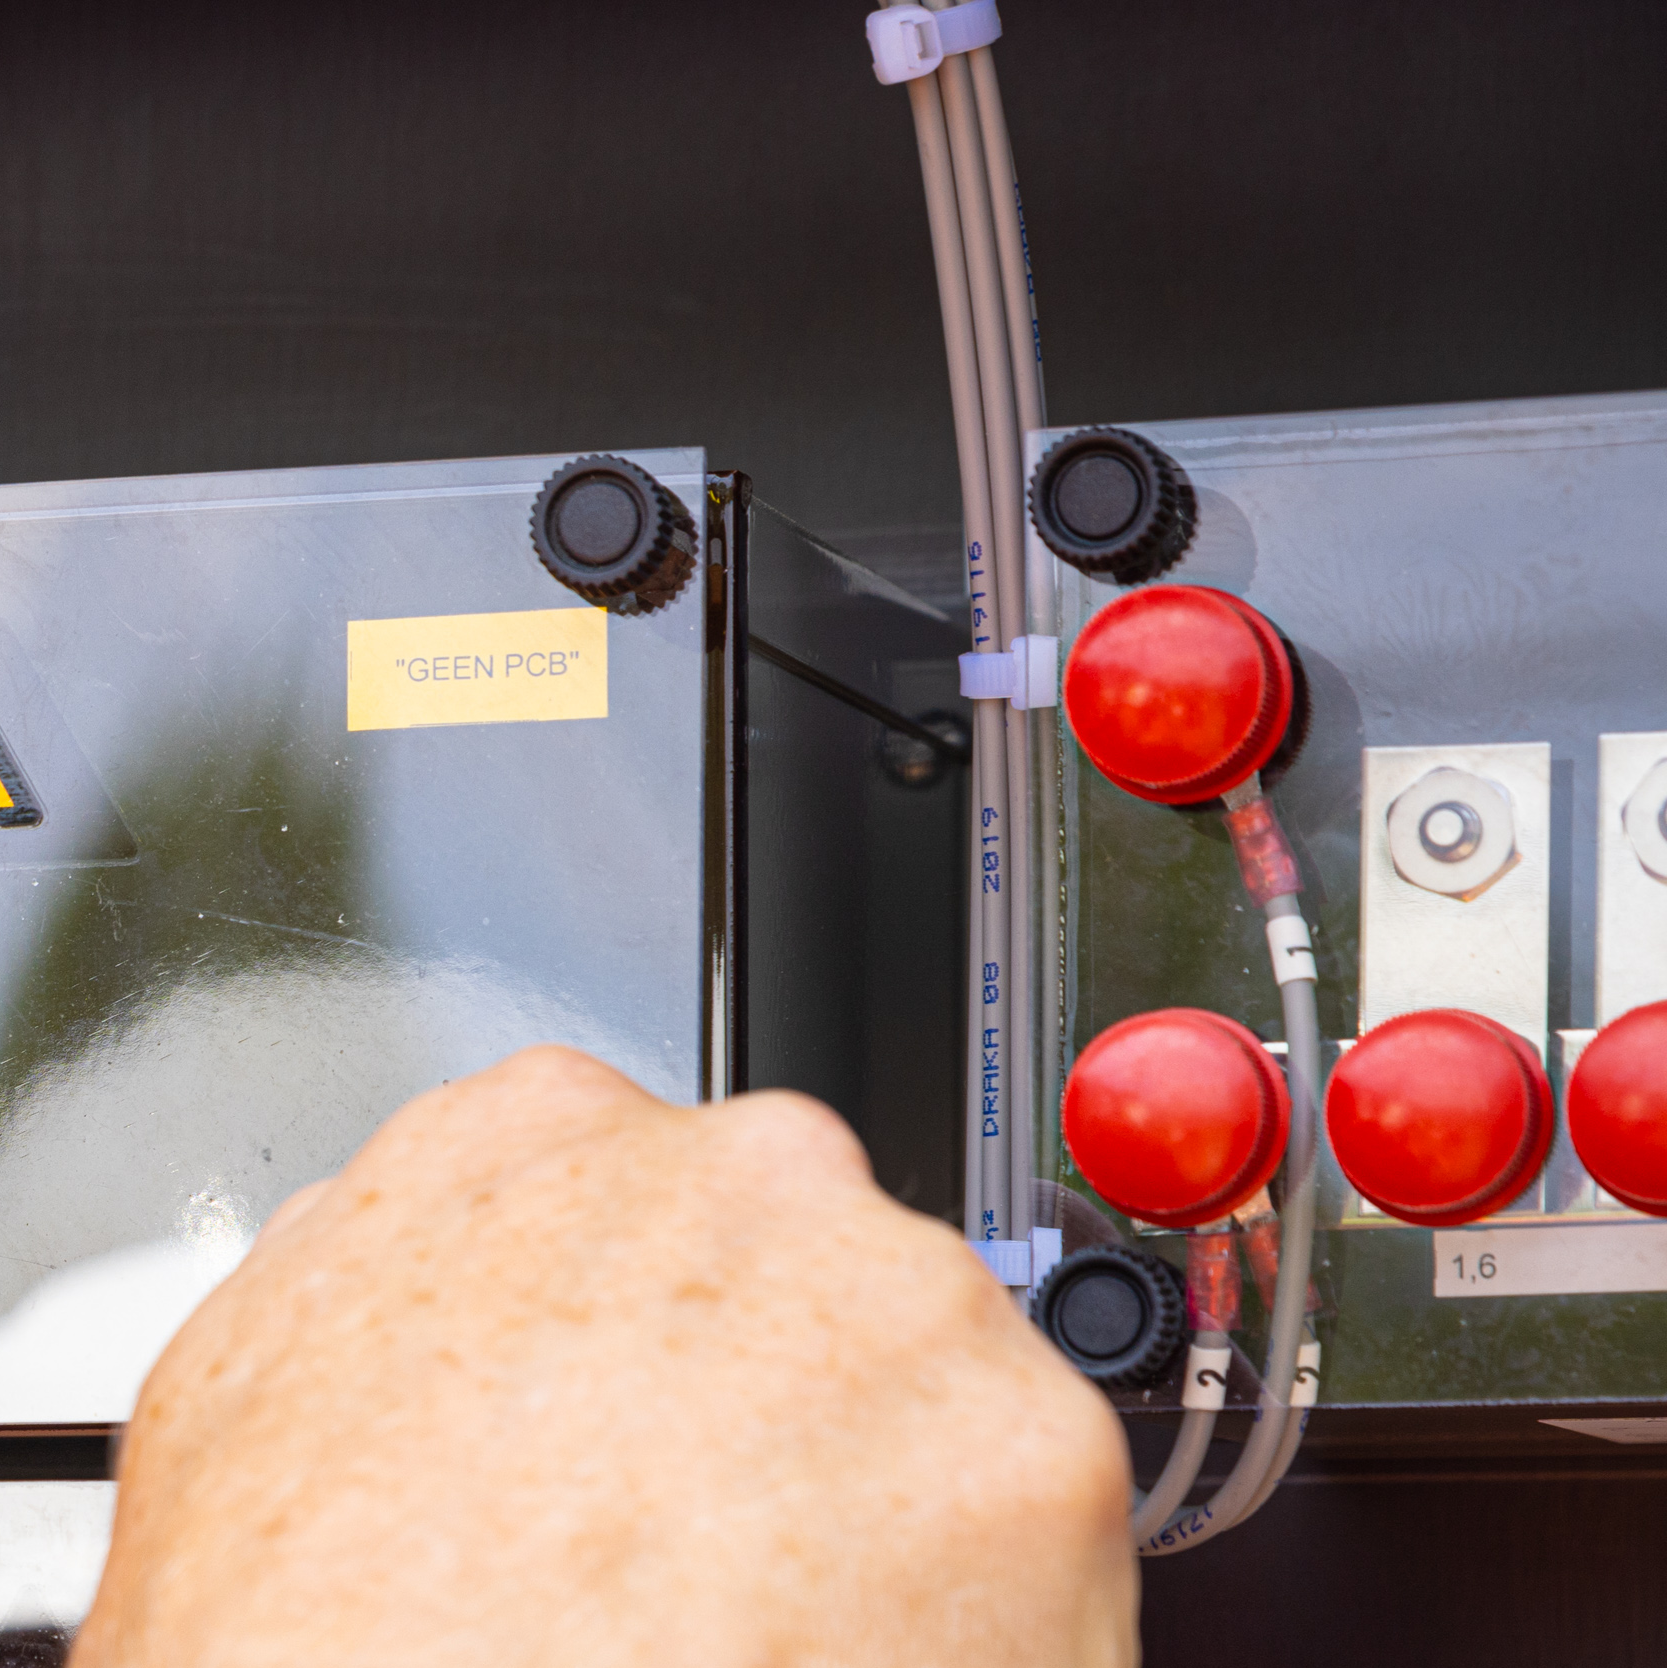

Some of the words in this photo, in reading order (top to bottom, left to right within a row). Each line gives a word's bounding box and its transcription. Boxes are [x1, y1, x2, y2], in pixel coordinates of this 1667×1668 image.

[969, 541, 990, 646] 19116
[396, 655, 494, 682] "GEEN
[505, 650, 580, 677] PCB"
[982, 807, 1001, 894] 2019
[983, 1028, 999, 1137] DRAKA
[1452, 1254, 1497, 1284] 1,6
[1196, 1367, 1227, 1389] 2
[1139, 1506, 1215, 1553] 17191
